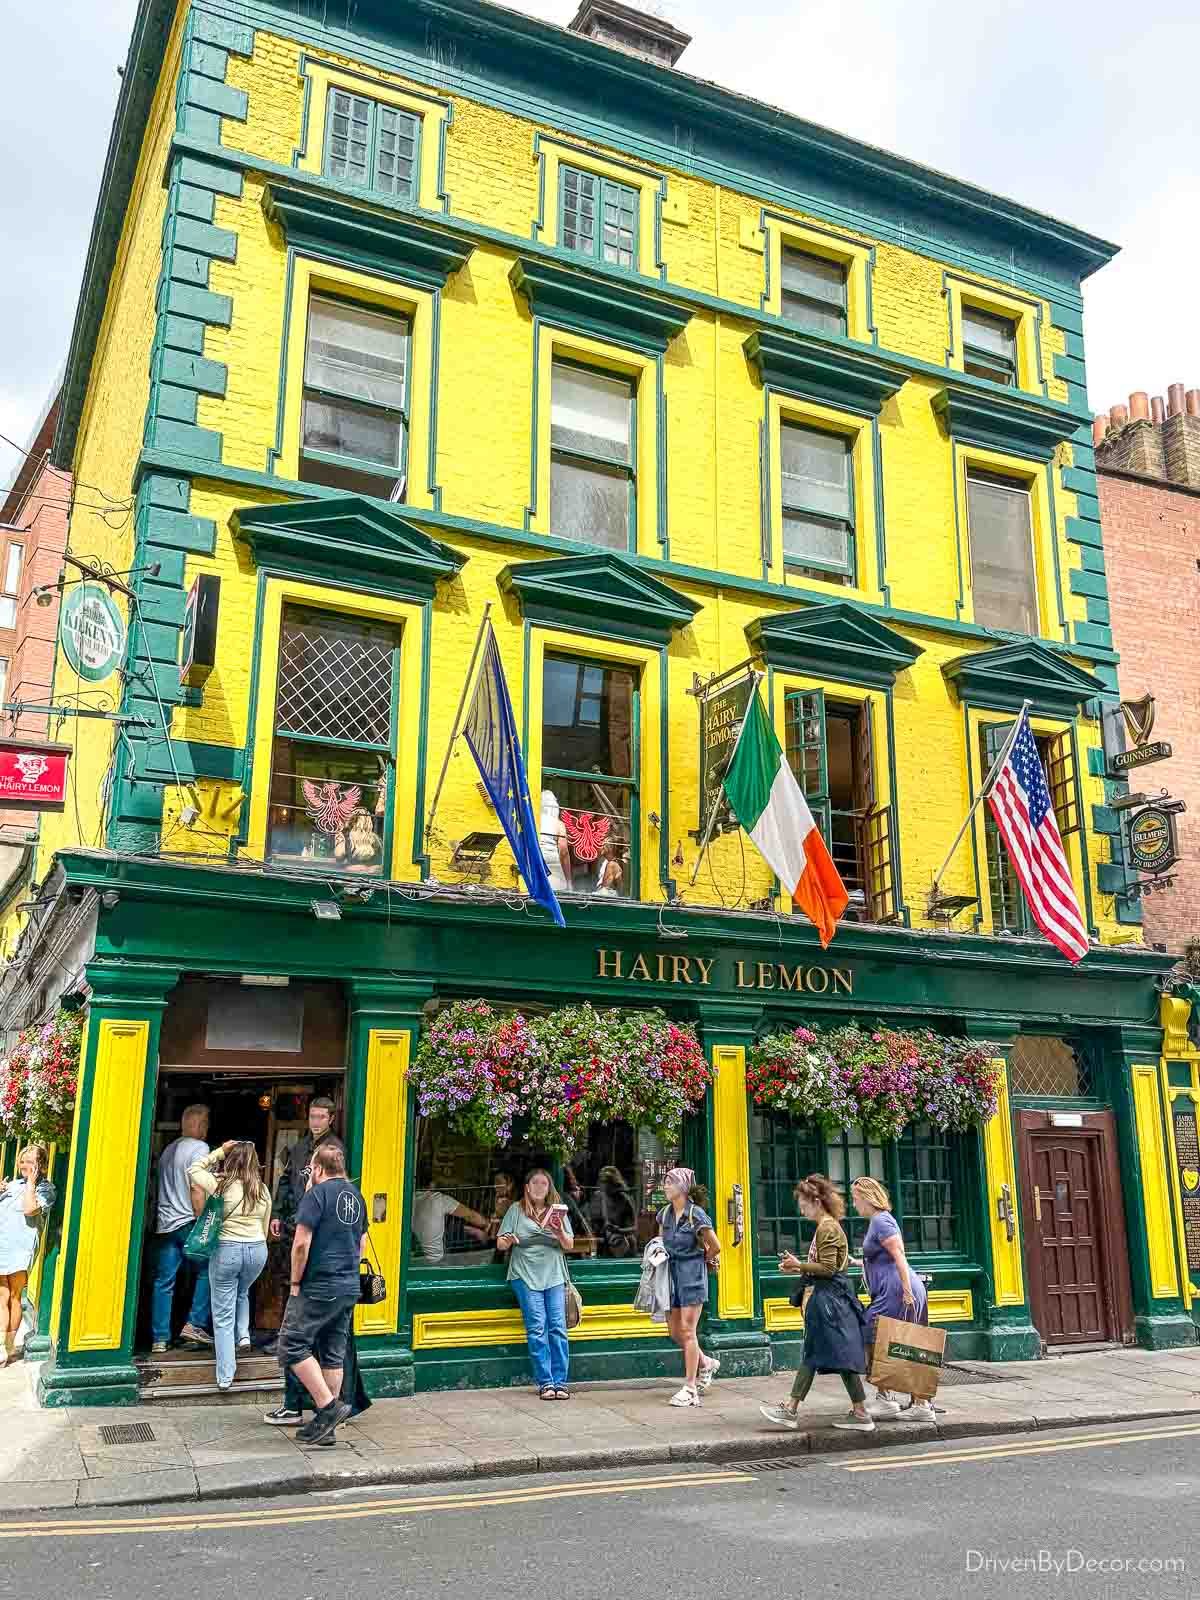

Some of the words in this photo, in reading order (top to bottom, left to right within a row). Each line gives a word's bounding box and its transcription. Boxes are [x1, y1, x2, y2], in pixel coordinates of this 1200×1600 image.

[713, 699, 727, 712] THE
[705, 706, 736, 731] HAIRY
[705, 727, 731, 750] LEMO
[1115, 745, 1159, 766] GUINNESS
[0, 782, 27, 791] HAIRY
[29, 783, 60, 793] LEMON
[1134, 828, 1168, 842] BULMERS
[1143, 849, 1172, 868] DRAUGHT
[596, 949, 716, 985] HAIRY
[735, 960, 854, 995] LEMON
